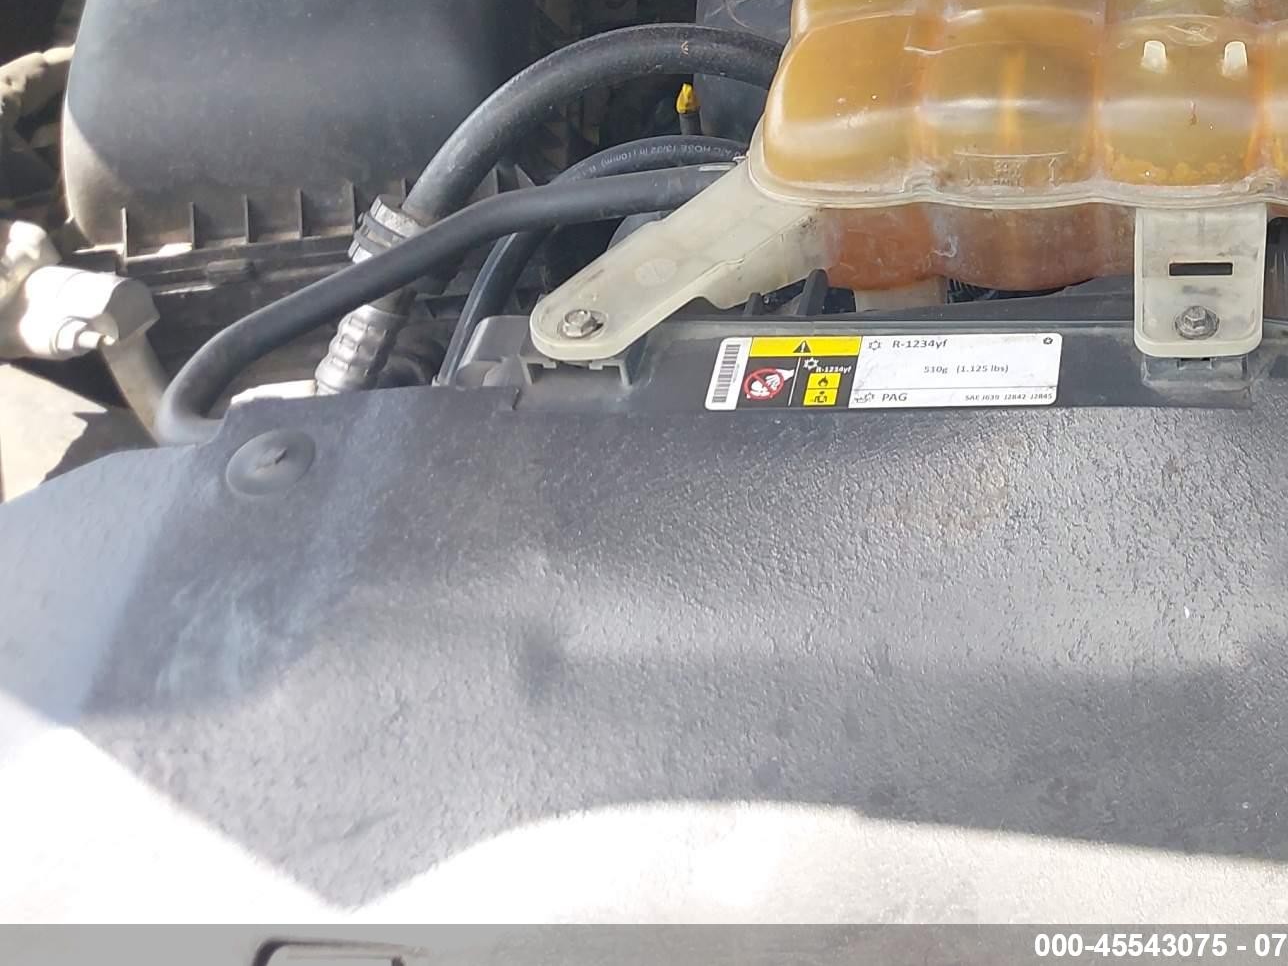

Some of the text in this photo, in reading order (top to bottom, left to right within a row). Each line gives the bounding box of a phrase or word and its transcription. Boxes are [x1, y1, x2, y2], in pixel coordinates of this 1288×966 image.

[892, 338, 949, 351] R-1234yf
[956, 364, 988, 375] (1.125
[990, 364, 1009, 374] lbs)
[881, 392, 908, 402] PAG
